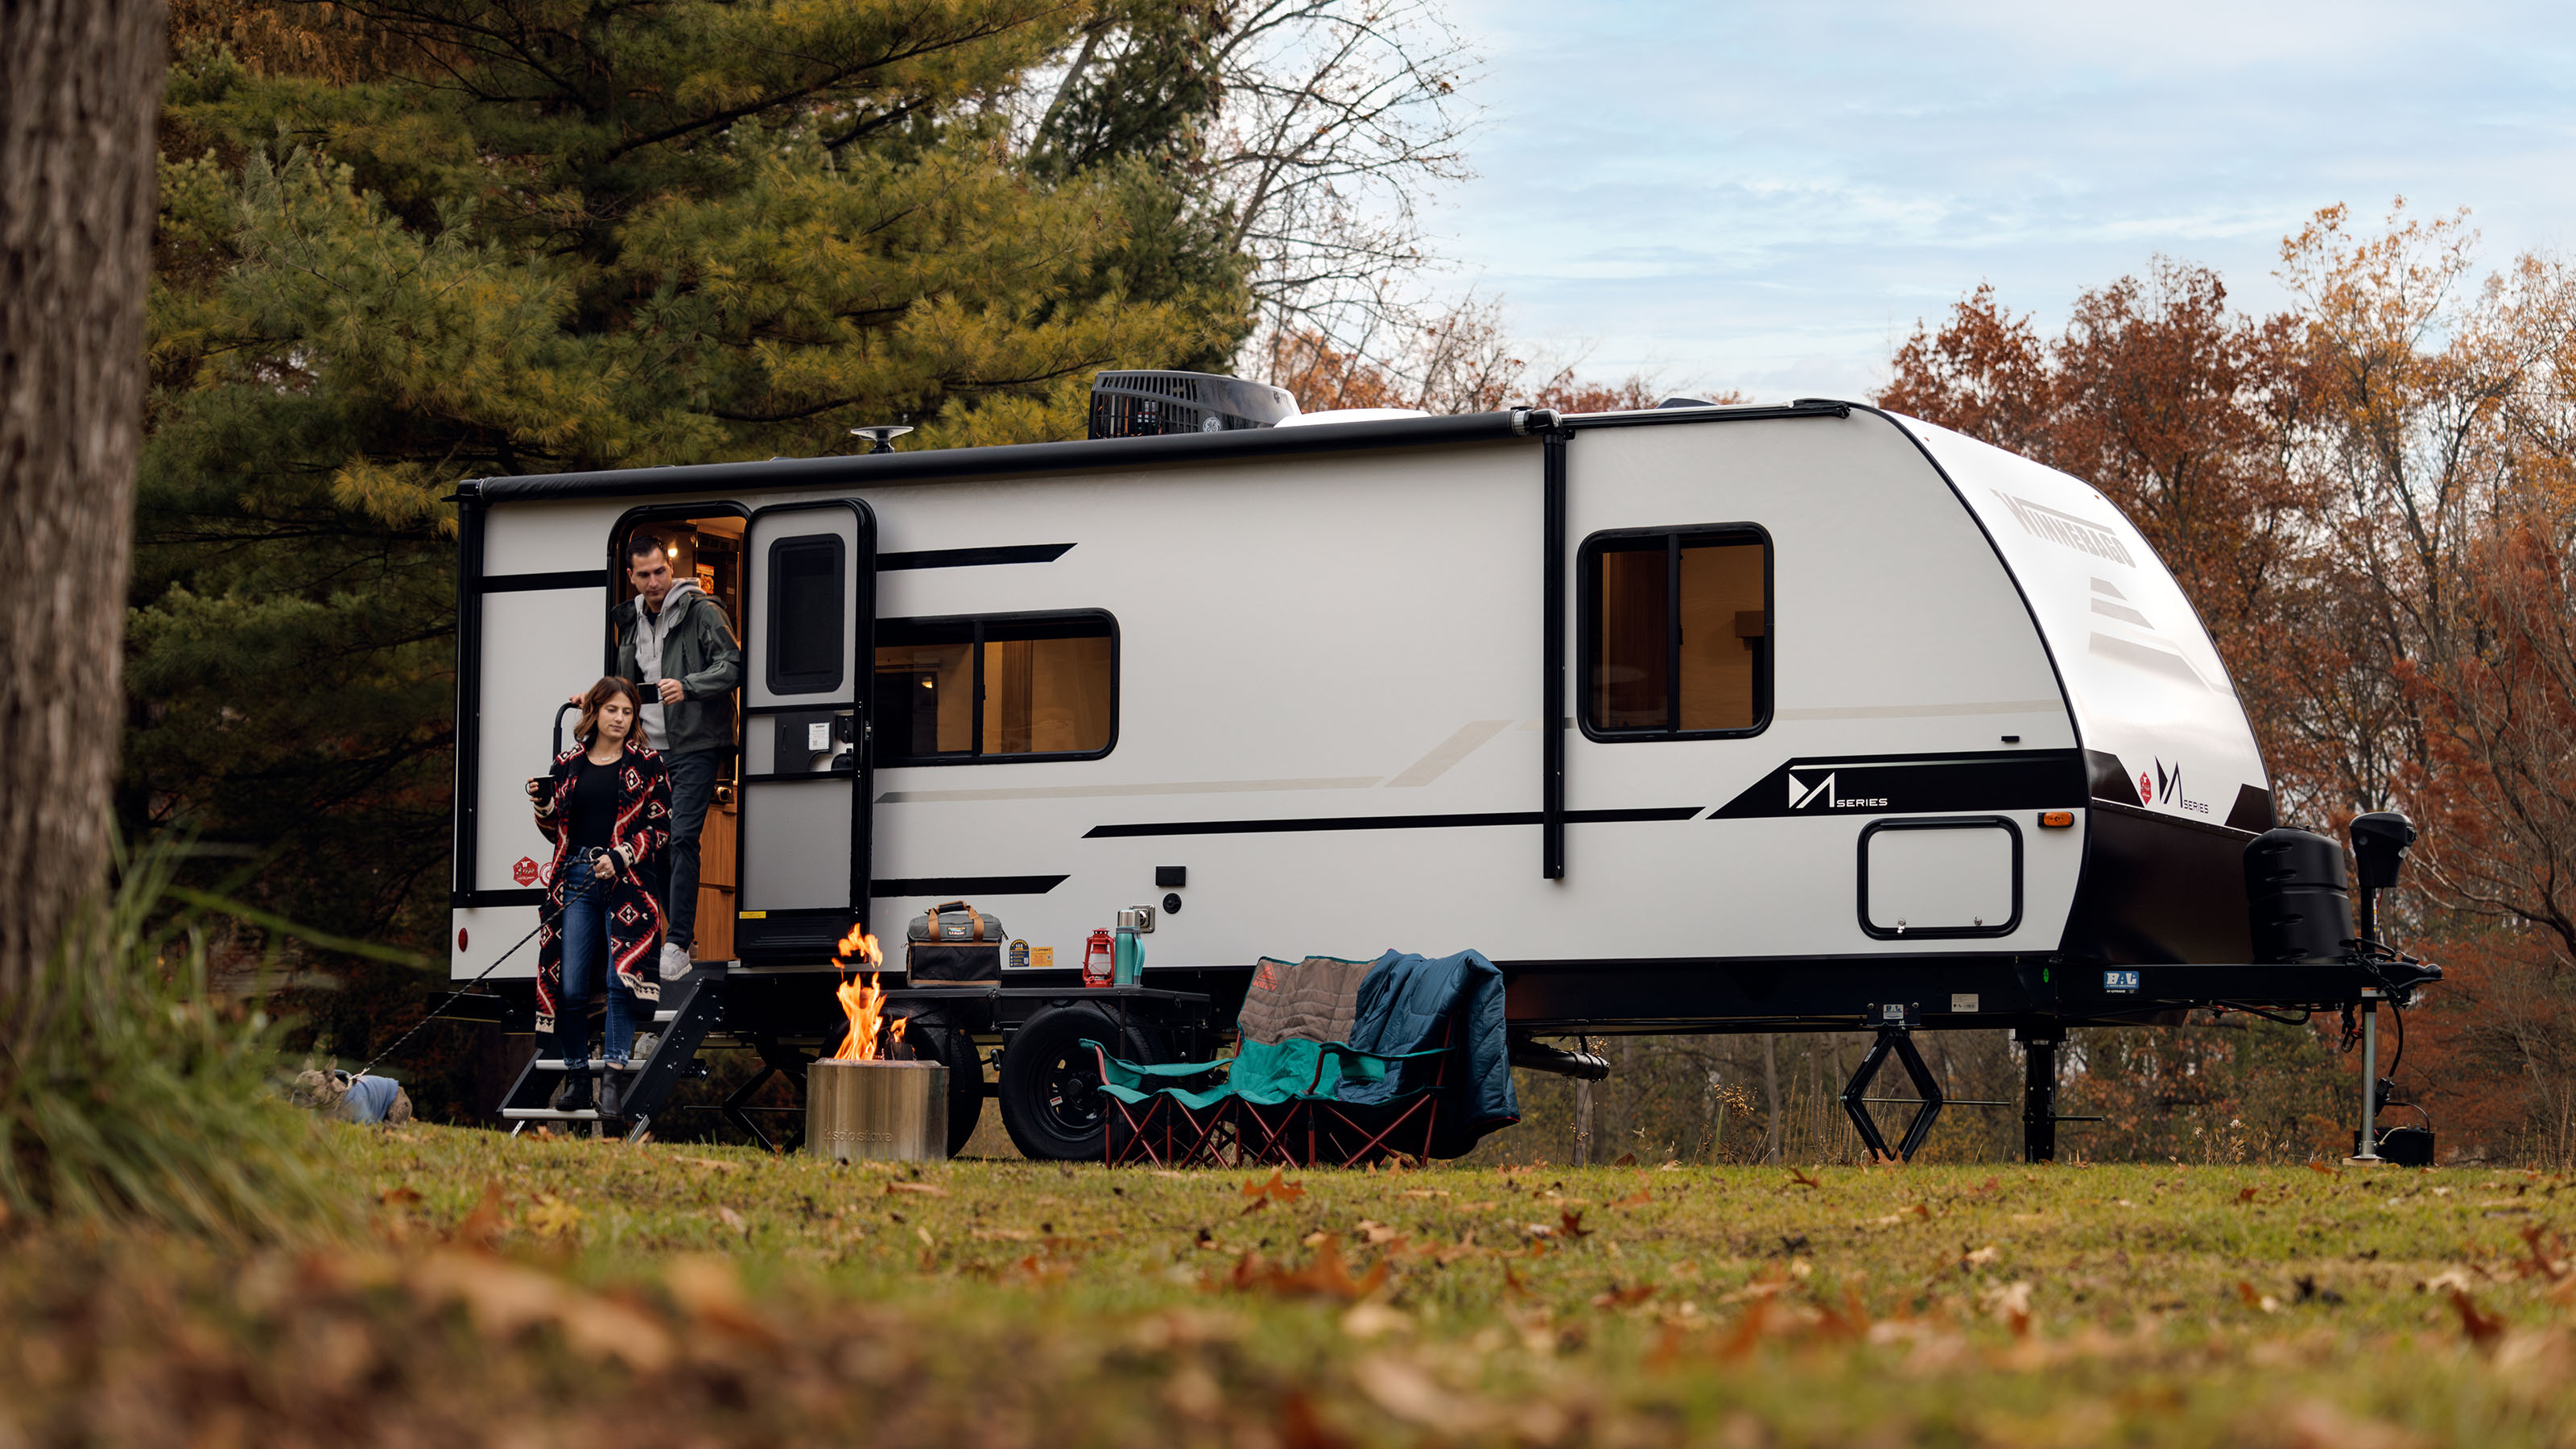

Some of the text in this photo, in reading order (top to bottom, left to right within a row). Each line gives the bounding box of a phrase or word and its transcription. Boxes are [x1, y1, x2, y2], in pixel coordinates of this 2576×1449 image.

[1989, 488, 2137, 568] WINNEBAGO
[1836, 798, 1889, 807] SERIES
[2183, 799, 2210, 814] SERIES
[1253, 979, 1278, 992] KELTY
